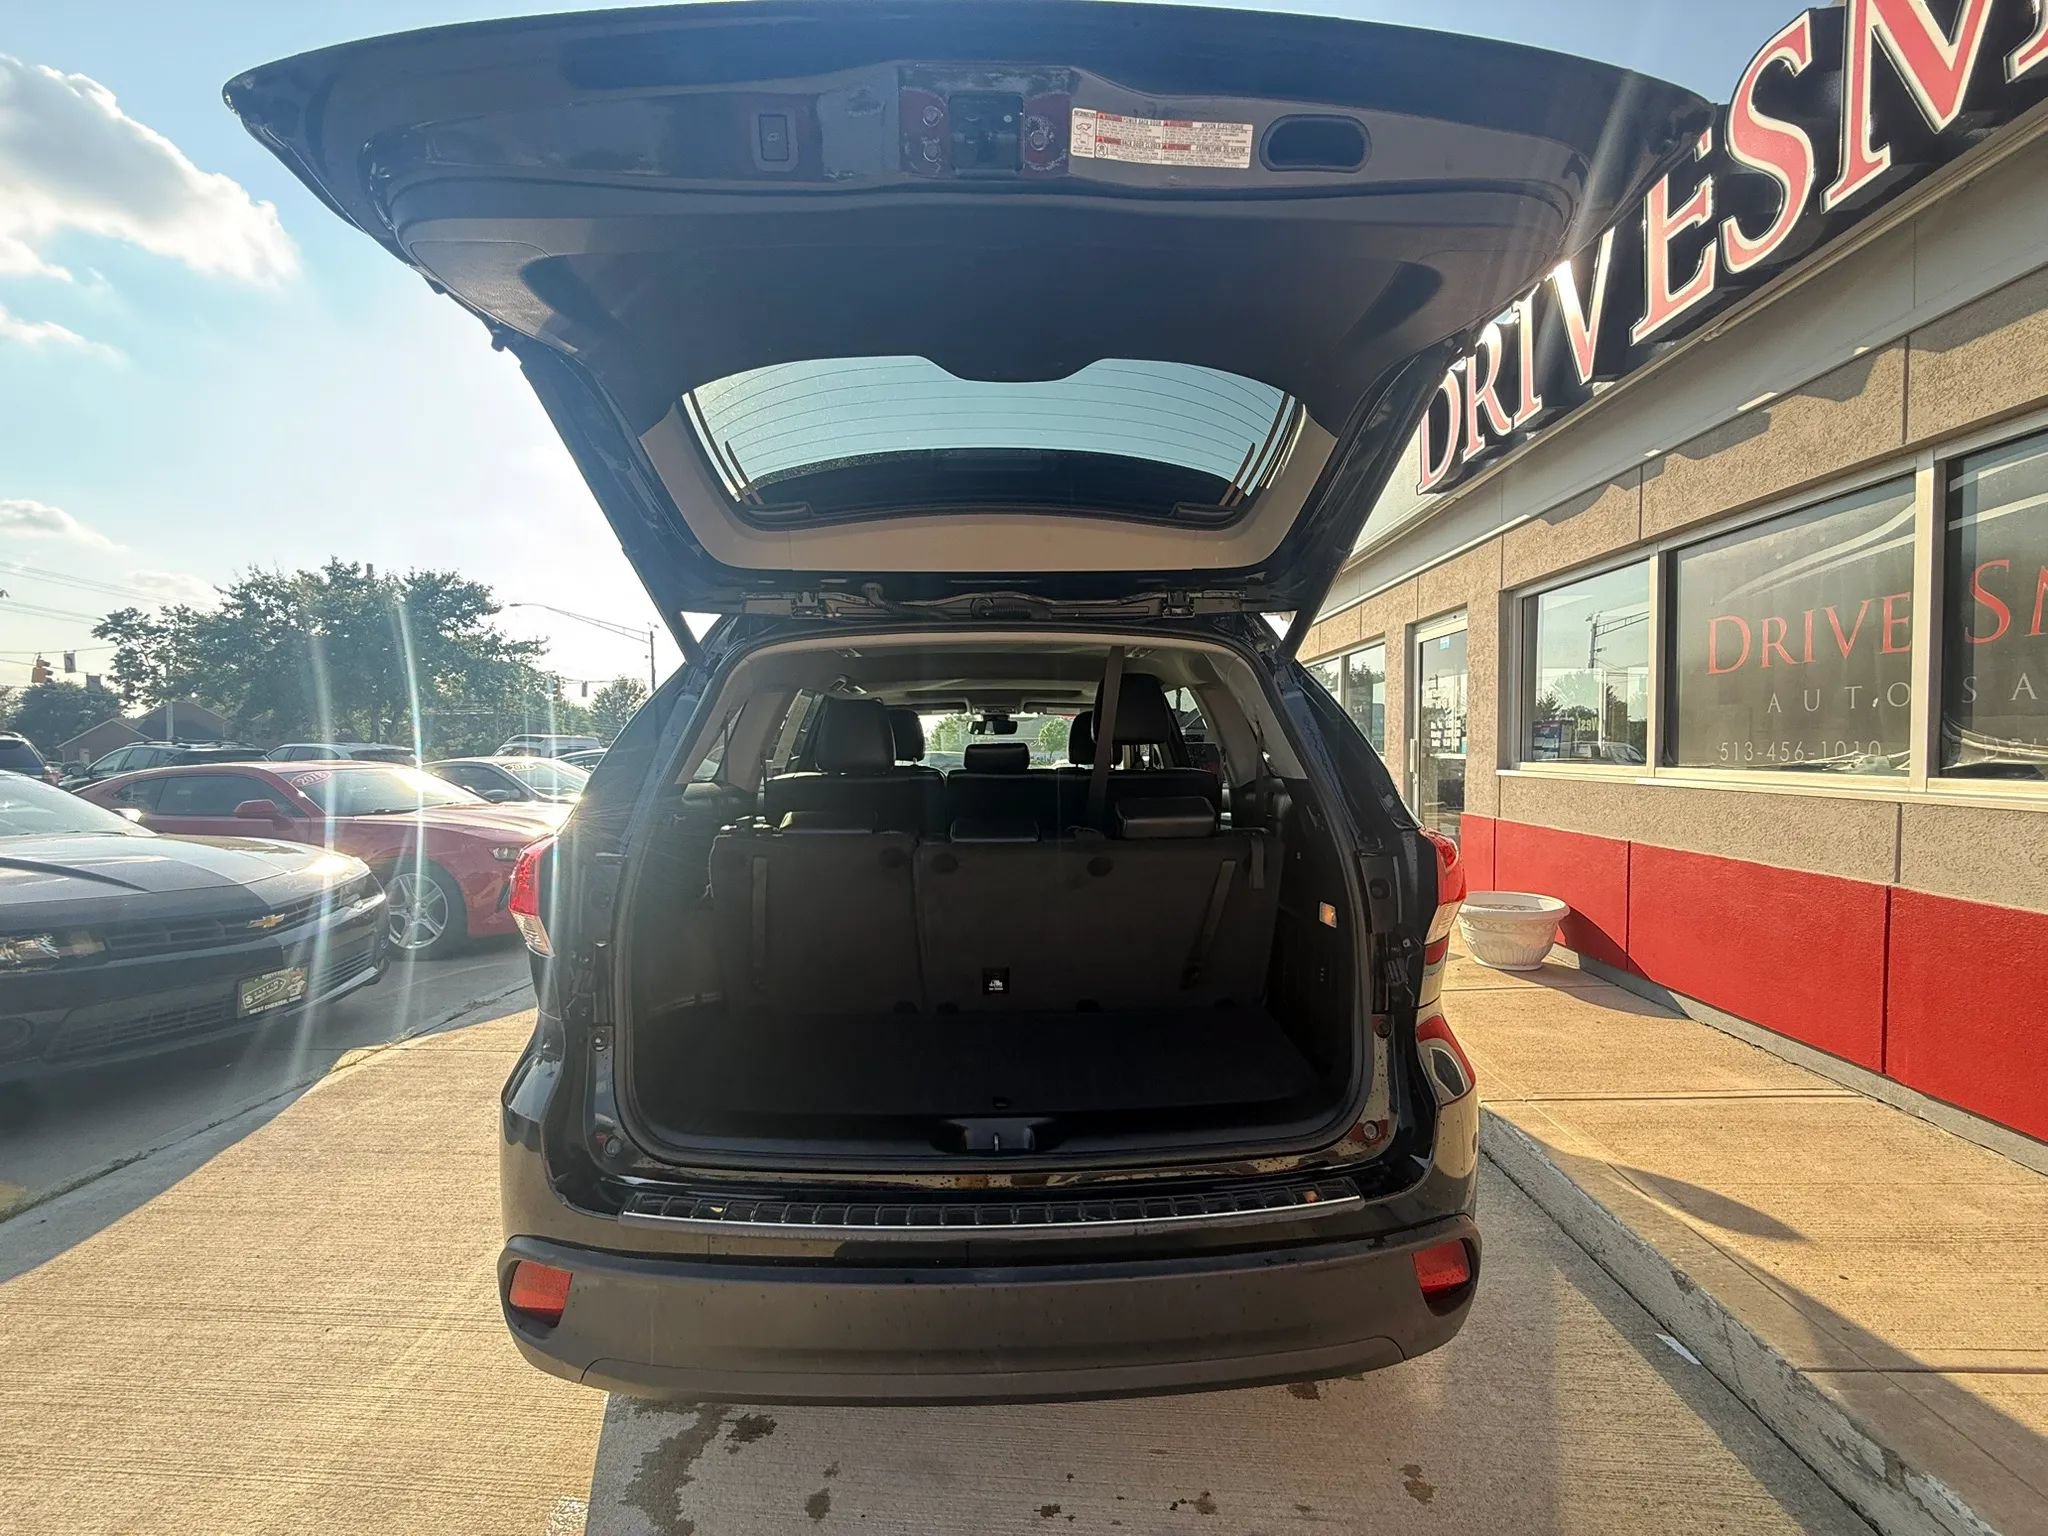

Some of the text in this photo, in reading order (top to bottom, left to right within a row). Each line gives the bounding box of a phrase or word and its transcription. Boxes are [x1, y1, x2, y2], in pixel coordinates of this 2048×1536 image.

[1707, 591, 1911, 675] DRIVE
[1767, 681, 1911, 713] AUTO
[1719, 740, 1882, 761] 513-456-1010
